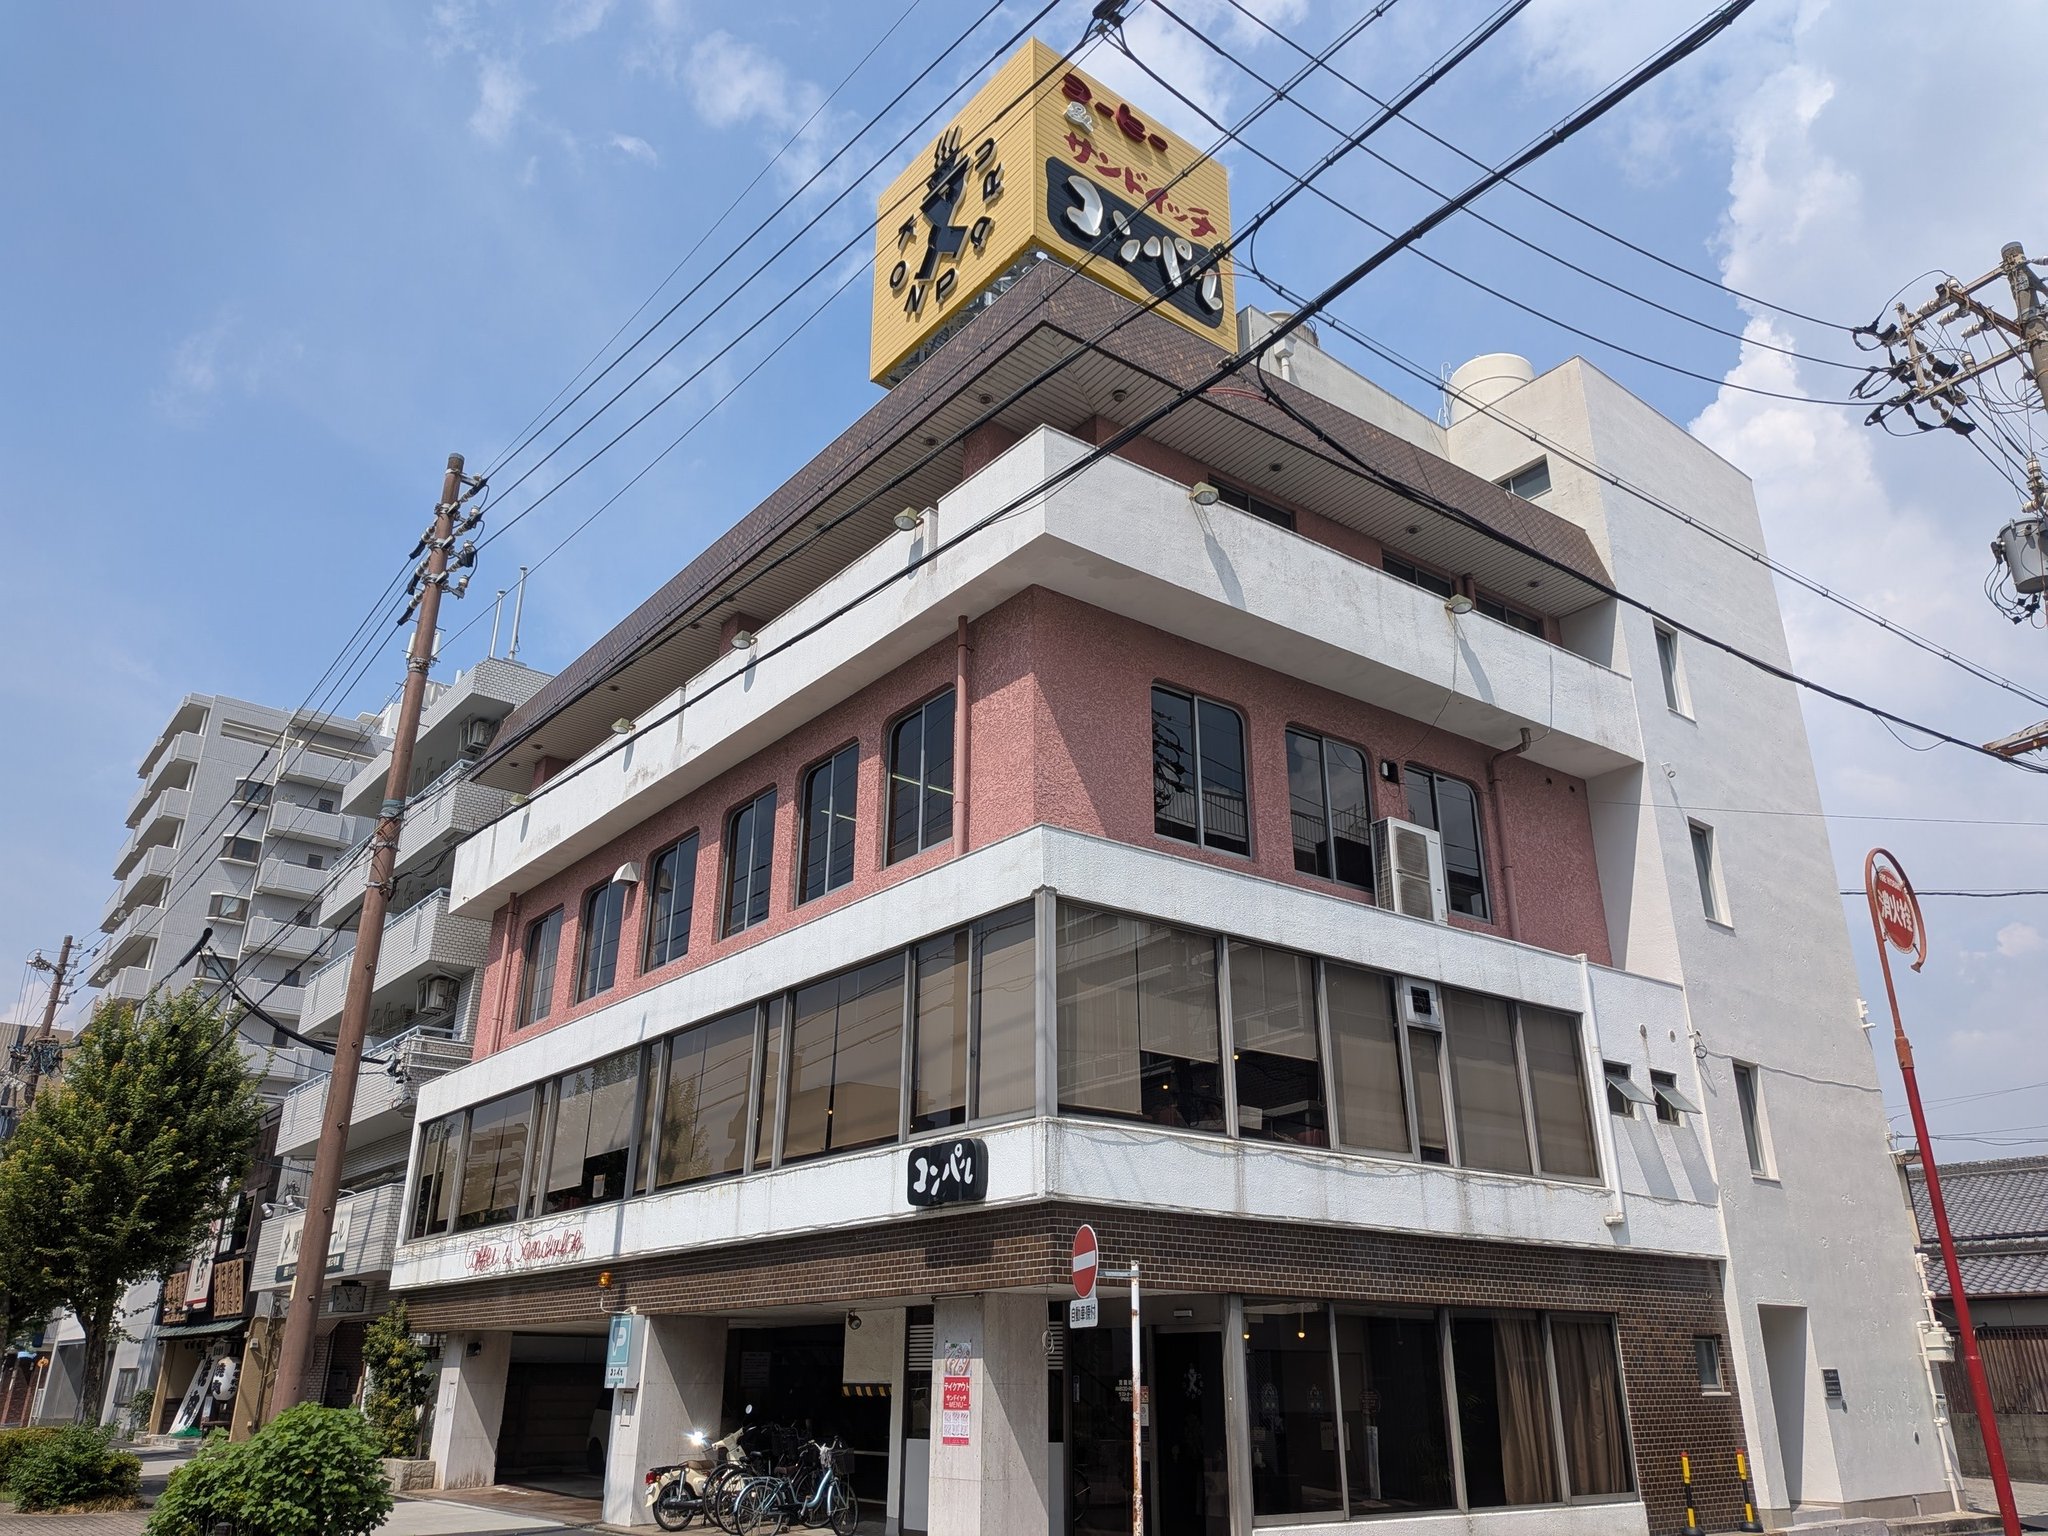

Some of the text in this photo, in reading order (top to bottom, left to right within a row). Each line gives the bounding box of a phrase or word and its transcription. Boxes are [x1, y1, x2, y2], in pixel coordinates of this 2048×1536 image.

[1062, 73, 1168, 152] コーヒー
[1064, 131, 1217, 237] サンドイッチ
[1067, 175, 1222, 311] コンパル
[1877, 889, 1914, 933] 消火栓
[913, 1143, 973, 1196] コンパル
[944, 1382, 970, 1391] テイクアウト
